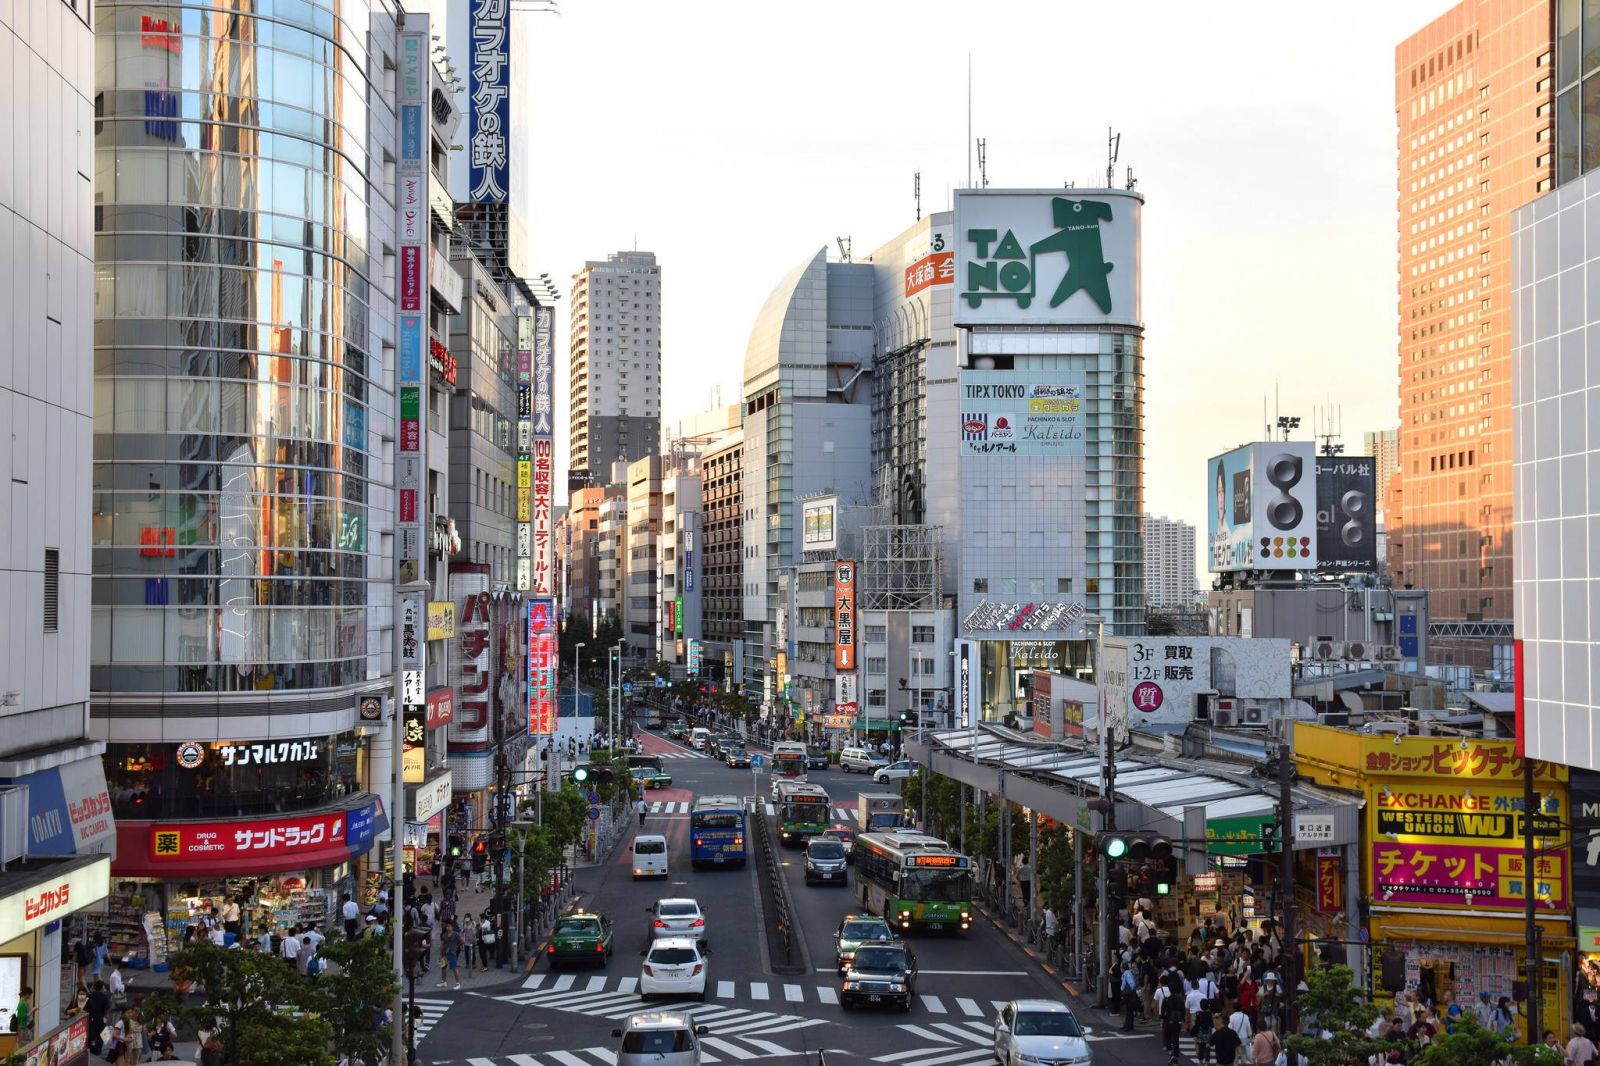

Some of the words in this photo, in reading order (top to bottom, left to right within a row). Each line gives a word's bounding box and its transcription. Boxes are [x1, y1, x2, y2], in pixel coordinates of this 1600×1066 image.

[472, 0, 508, 200] カラオケの鉄人
[968, 229, 1026, 259] TA
[968, 260, 1030, 292] NO
[534, 307, 551, 434] カラオケの鉄人
[993, 384, 1025, 398] TOKYO
[1021, 425, 1082, 440] Kaleido
[534, 440, 551, 595] 100名収容大パーティールーム
[838, 567, 851, 581] 質
[838, 596, 851, 645] 大黒屋
[1022, 601, 1050, 631] ワンカラ
[460, 591, 491, 730] パチンコ
[1009, 647, 1059, 659] Kaleido
[1133, 643, 1154, 661] 3F
[1164, 645, 1193, 660] 買取
[1164, 666, 1193, 680] 販売
[404, 672, 413, 704] ノアール
[1138, 686, 1158, 707] 質
[220, 741, 318, 766] サンマルクカフェ
[69, 792, 110, 825] ビックカメラ
[1377, 792, 1490, 811] EXCHANGE
[31, 808, 63, 844] ODAKYU
[89, 819, 109, 837] CAMERA
[1382, 812, 1454, 823] WESTERN
[1405, 822, 1454, 833] UNION
[1462, 815, 1506, 836] WU
[158, 832, 178, 855] 薬
[196, 832, 217, 840] DRUG
[234, 823, 325, 850] サンドラッグ
[188, 843, 225, 852] COSMETIC
[1378, 850, 1494, 880] チケット
[1508, 858, 1551, 873] 販売
[1320, 861, 1333, 908] チケット
[1378, 877, 1439, 885] TICKET
[1455, 880, 1495, 888] SHOP
[1509, 880, 1552, 895] 買取
[25, 883, 70, 921] ビックカメラ
